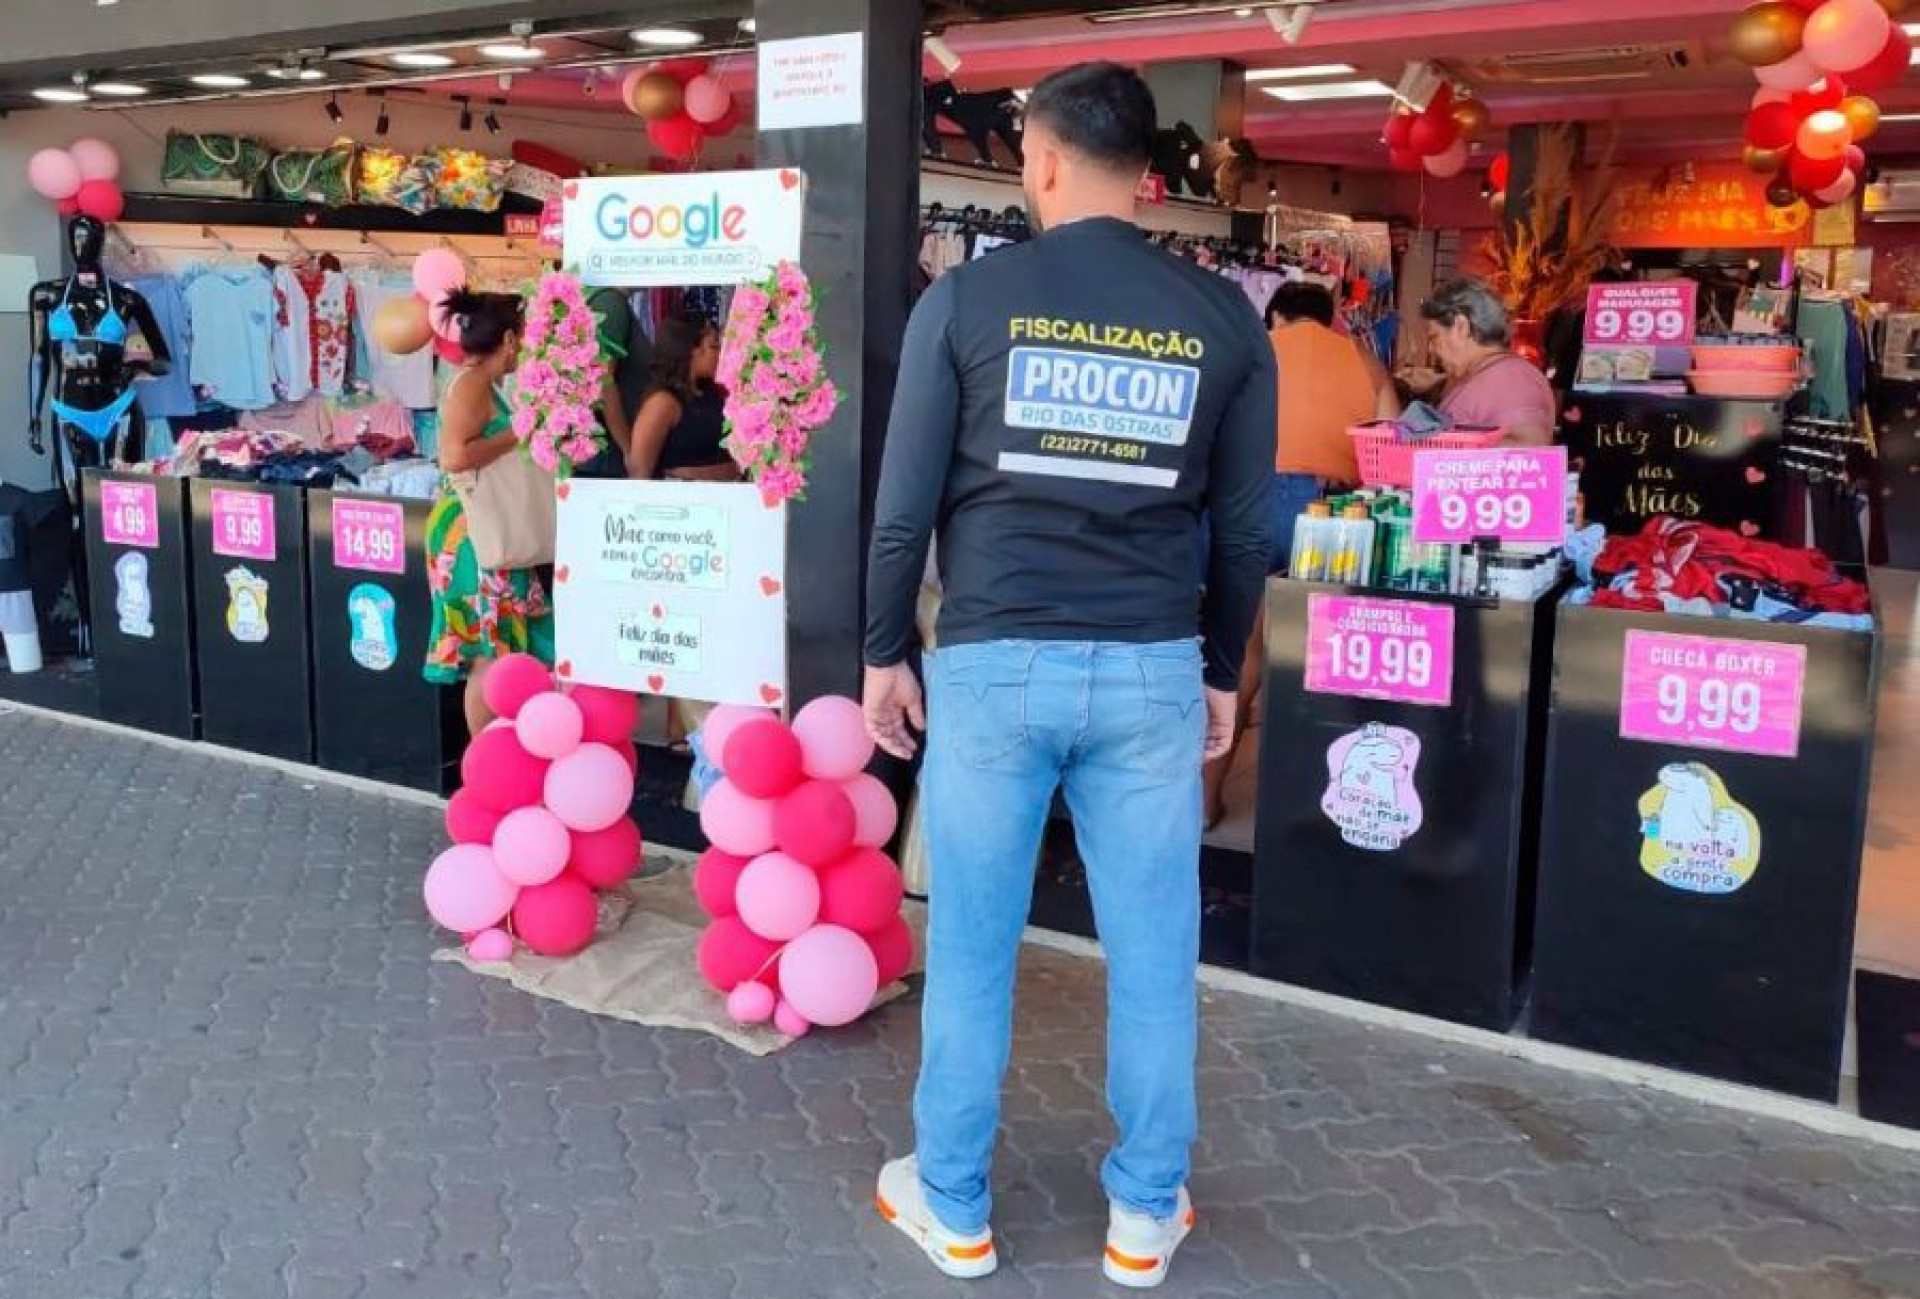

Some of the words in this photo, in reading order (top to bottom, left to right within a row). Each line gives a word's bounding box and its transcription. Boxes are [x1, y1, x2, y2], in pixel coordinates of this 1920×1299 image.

[597, 191, 747, 247] Google
[1009, 317, 1203, 359] FISCALIZAÇÃO
[1023, 355, 1185, 415] PROCON
[1021, 406, 1054, 423] RIO
[1060, 409, 1097, 429] DAS
[1104, 414, 1174, 439] OSTRAS
[1597, 422, 1650, 455] Feliz
[1435, 459, 1493, 475] CREME
[1496, 457, 1542, 472] PARA
[1638, 464, 1674, 480] das
[1427, 477, 1503, 490] PENTEAR
[1441, 494, 1531, 532] 9,99
[1624, 484, 1700, 516] Mães
[225, 515, 262, 547] 9,99
[342, 526, 394, 562] 14,99
[604, 513, 644, 545] Mãe
[648, 530, 681, 543] como
[642, 545, 723, 576] Google
[620, 622, 647, 642] Feliz
[650, 627, 671, 645] dia
[674, 631, 698, 649] das
[639, 646, 675, 666] mães
[1327, 632, 1432, 688] 19,99
[1715, 652, 1776, 677] BOXER
[1656, 673, 1762, 733] 9,99
[1690, 838, 1735, 858] volta
[1663, 867, 1733, 887] compra
